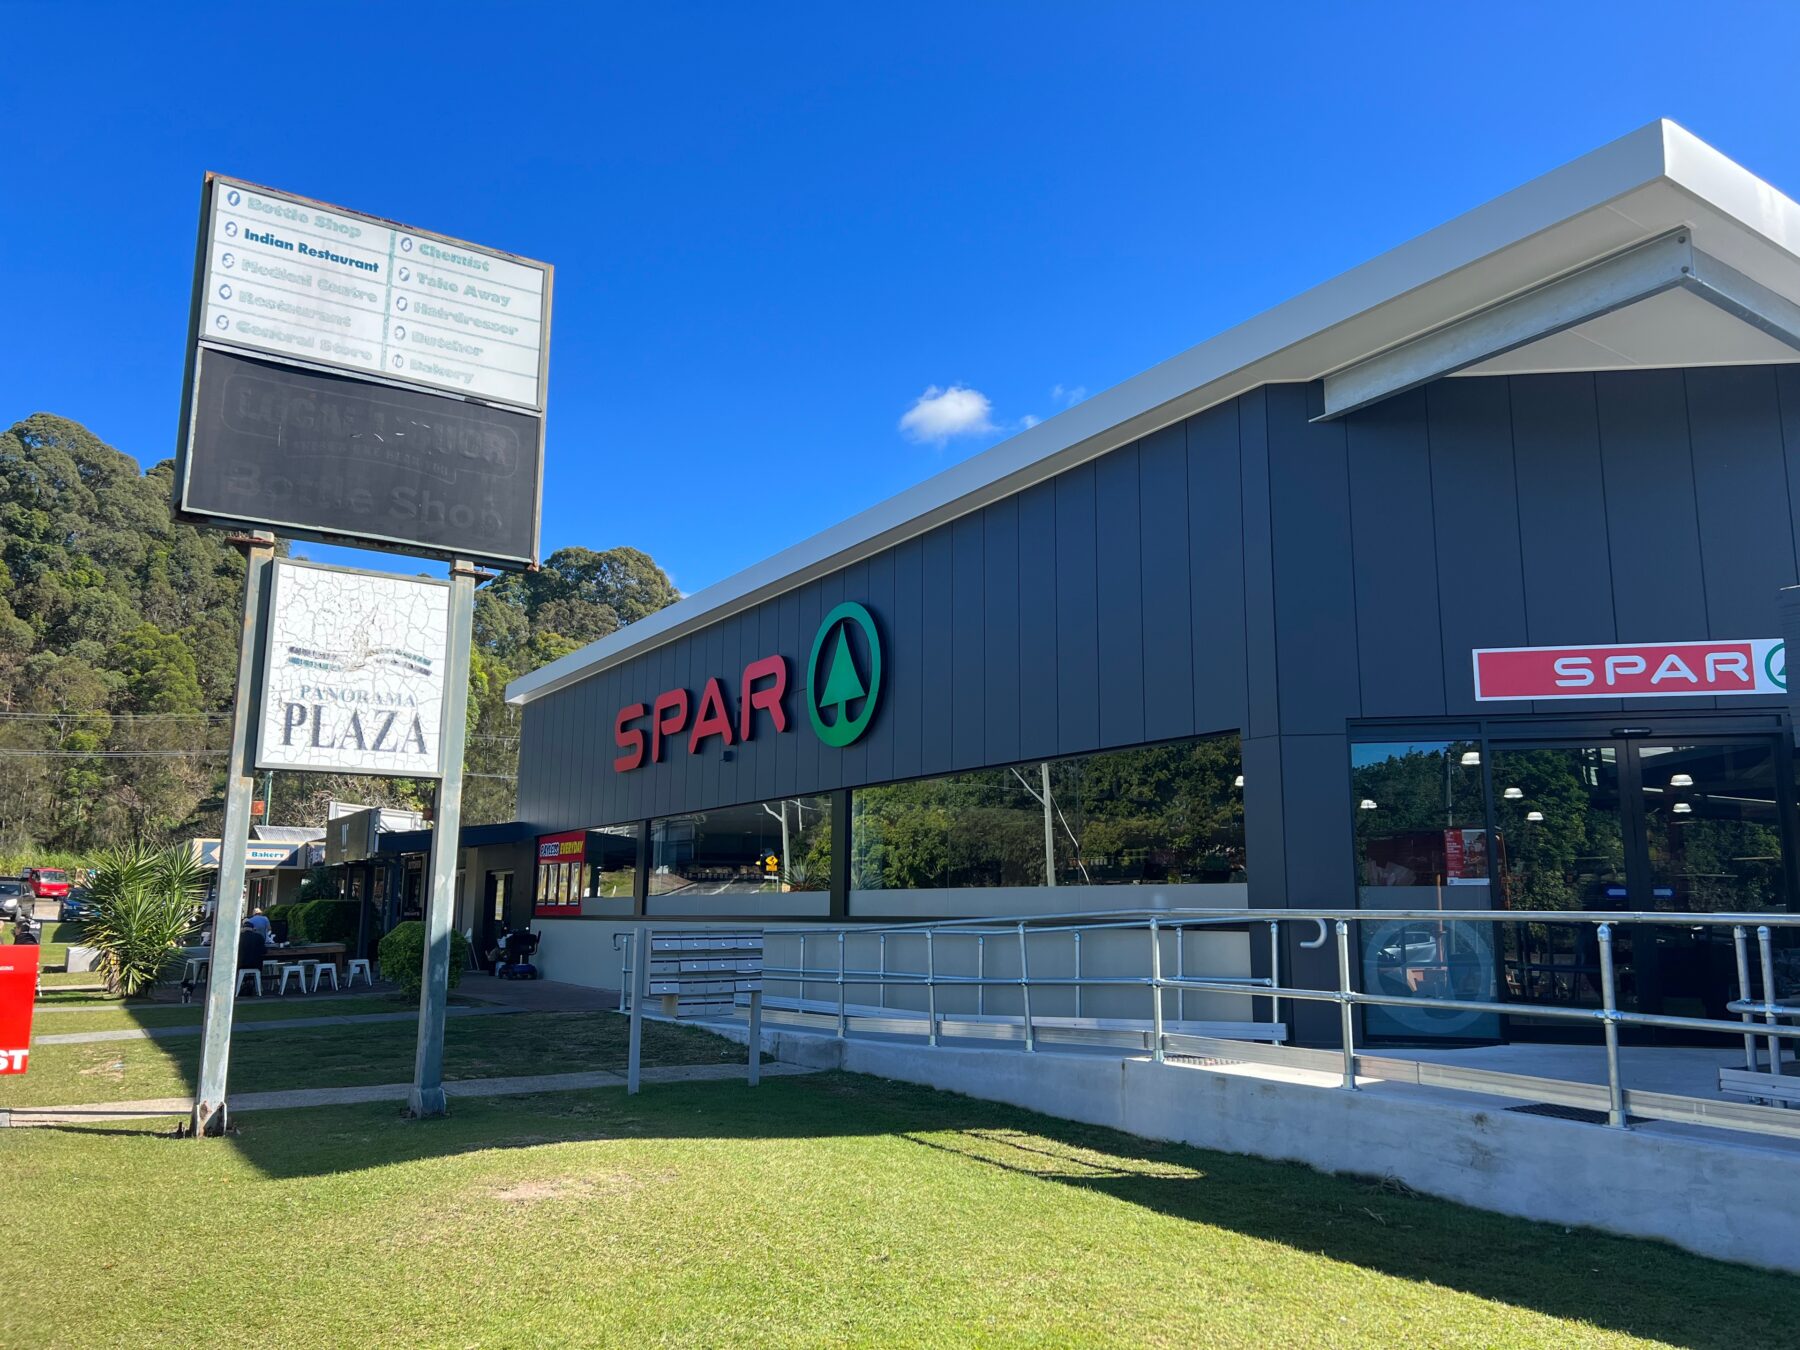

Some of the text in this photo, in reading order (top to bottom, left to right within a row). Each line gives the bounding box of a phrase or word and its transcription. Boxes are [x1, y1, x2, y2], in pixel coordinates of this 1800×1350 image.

[314, 215, 361, 238] Shop
[245, 228, 294, 251] Indian
[298, 242, 379, 272] Restaurant
[419, 243, 490, 272] Chemist
[417, 272, 458, 292] Take
[463, 284, 511, 307] Away
[1553, 651, 1749, 687] SPAR
[300, 684, 416, 708] PANORAMA
[613, 654, 788, 773] SPAR
[279, 701, 429, 754] PLAZA
